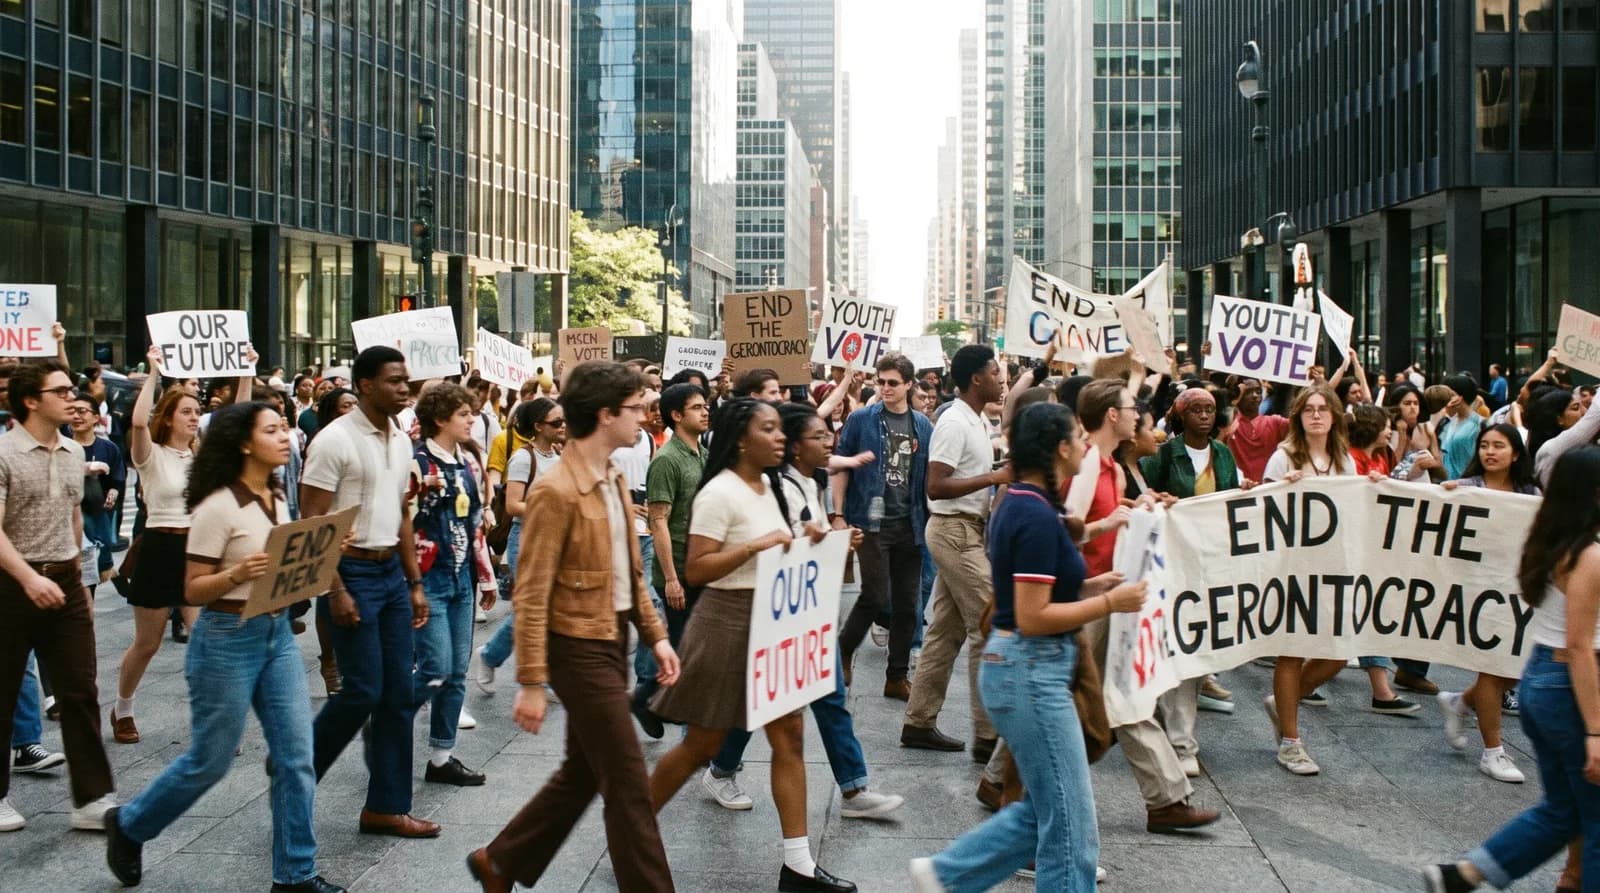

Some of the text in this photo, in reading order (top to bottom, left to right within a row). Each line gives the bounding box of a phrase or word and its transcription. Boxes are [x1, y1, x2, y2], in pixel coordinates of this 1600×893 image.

[745, 294, 793, 319] END
[831, 297, 895, 333] YOUTH
[1030, 271, 1096, 318] END
[178, 313, 229, 340] OUR
[746, 321, 783, 339] THE
[1219, 301, 1309, 342] YOUTH
[161, 341, 250, 372] FUTURE
[573, 347, 609, 361] VOTE
[730, 338, 808, 360] GERONTOCRACY
[825, 326, 889, 369] VOTE
[1217, 332, 1313, 382] VOTE
[280, 523, 336, 567] END
[1225, 491, 1490, 562] END THE
[771, 560, 819, 621] OUR
[1173, 574, 1534, 657] GERONTOCRACY
[753, 623, 832, 711] FUTURE
